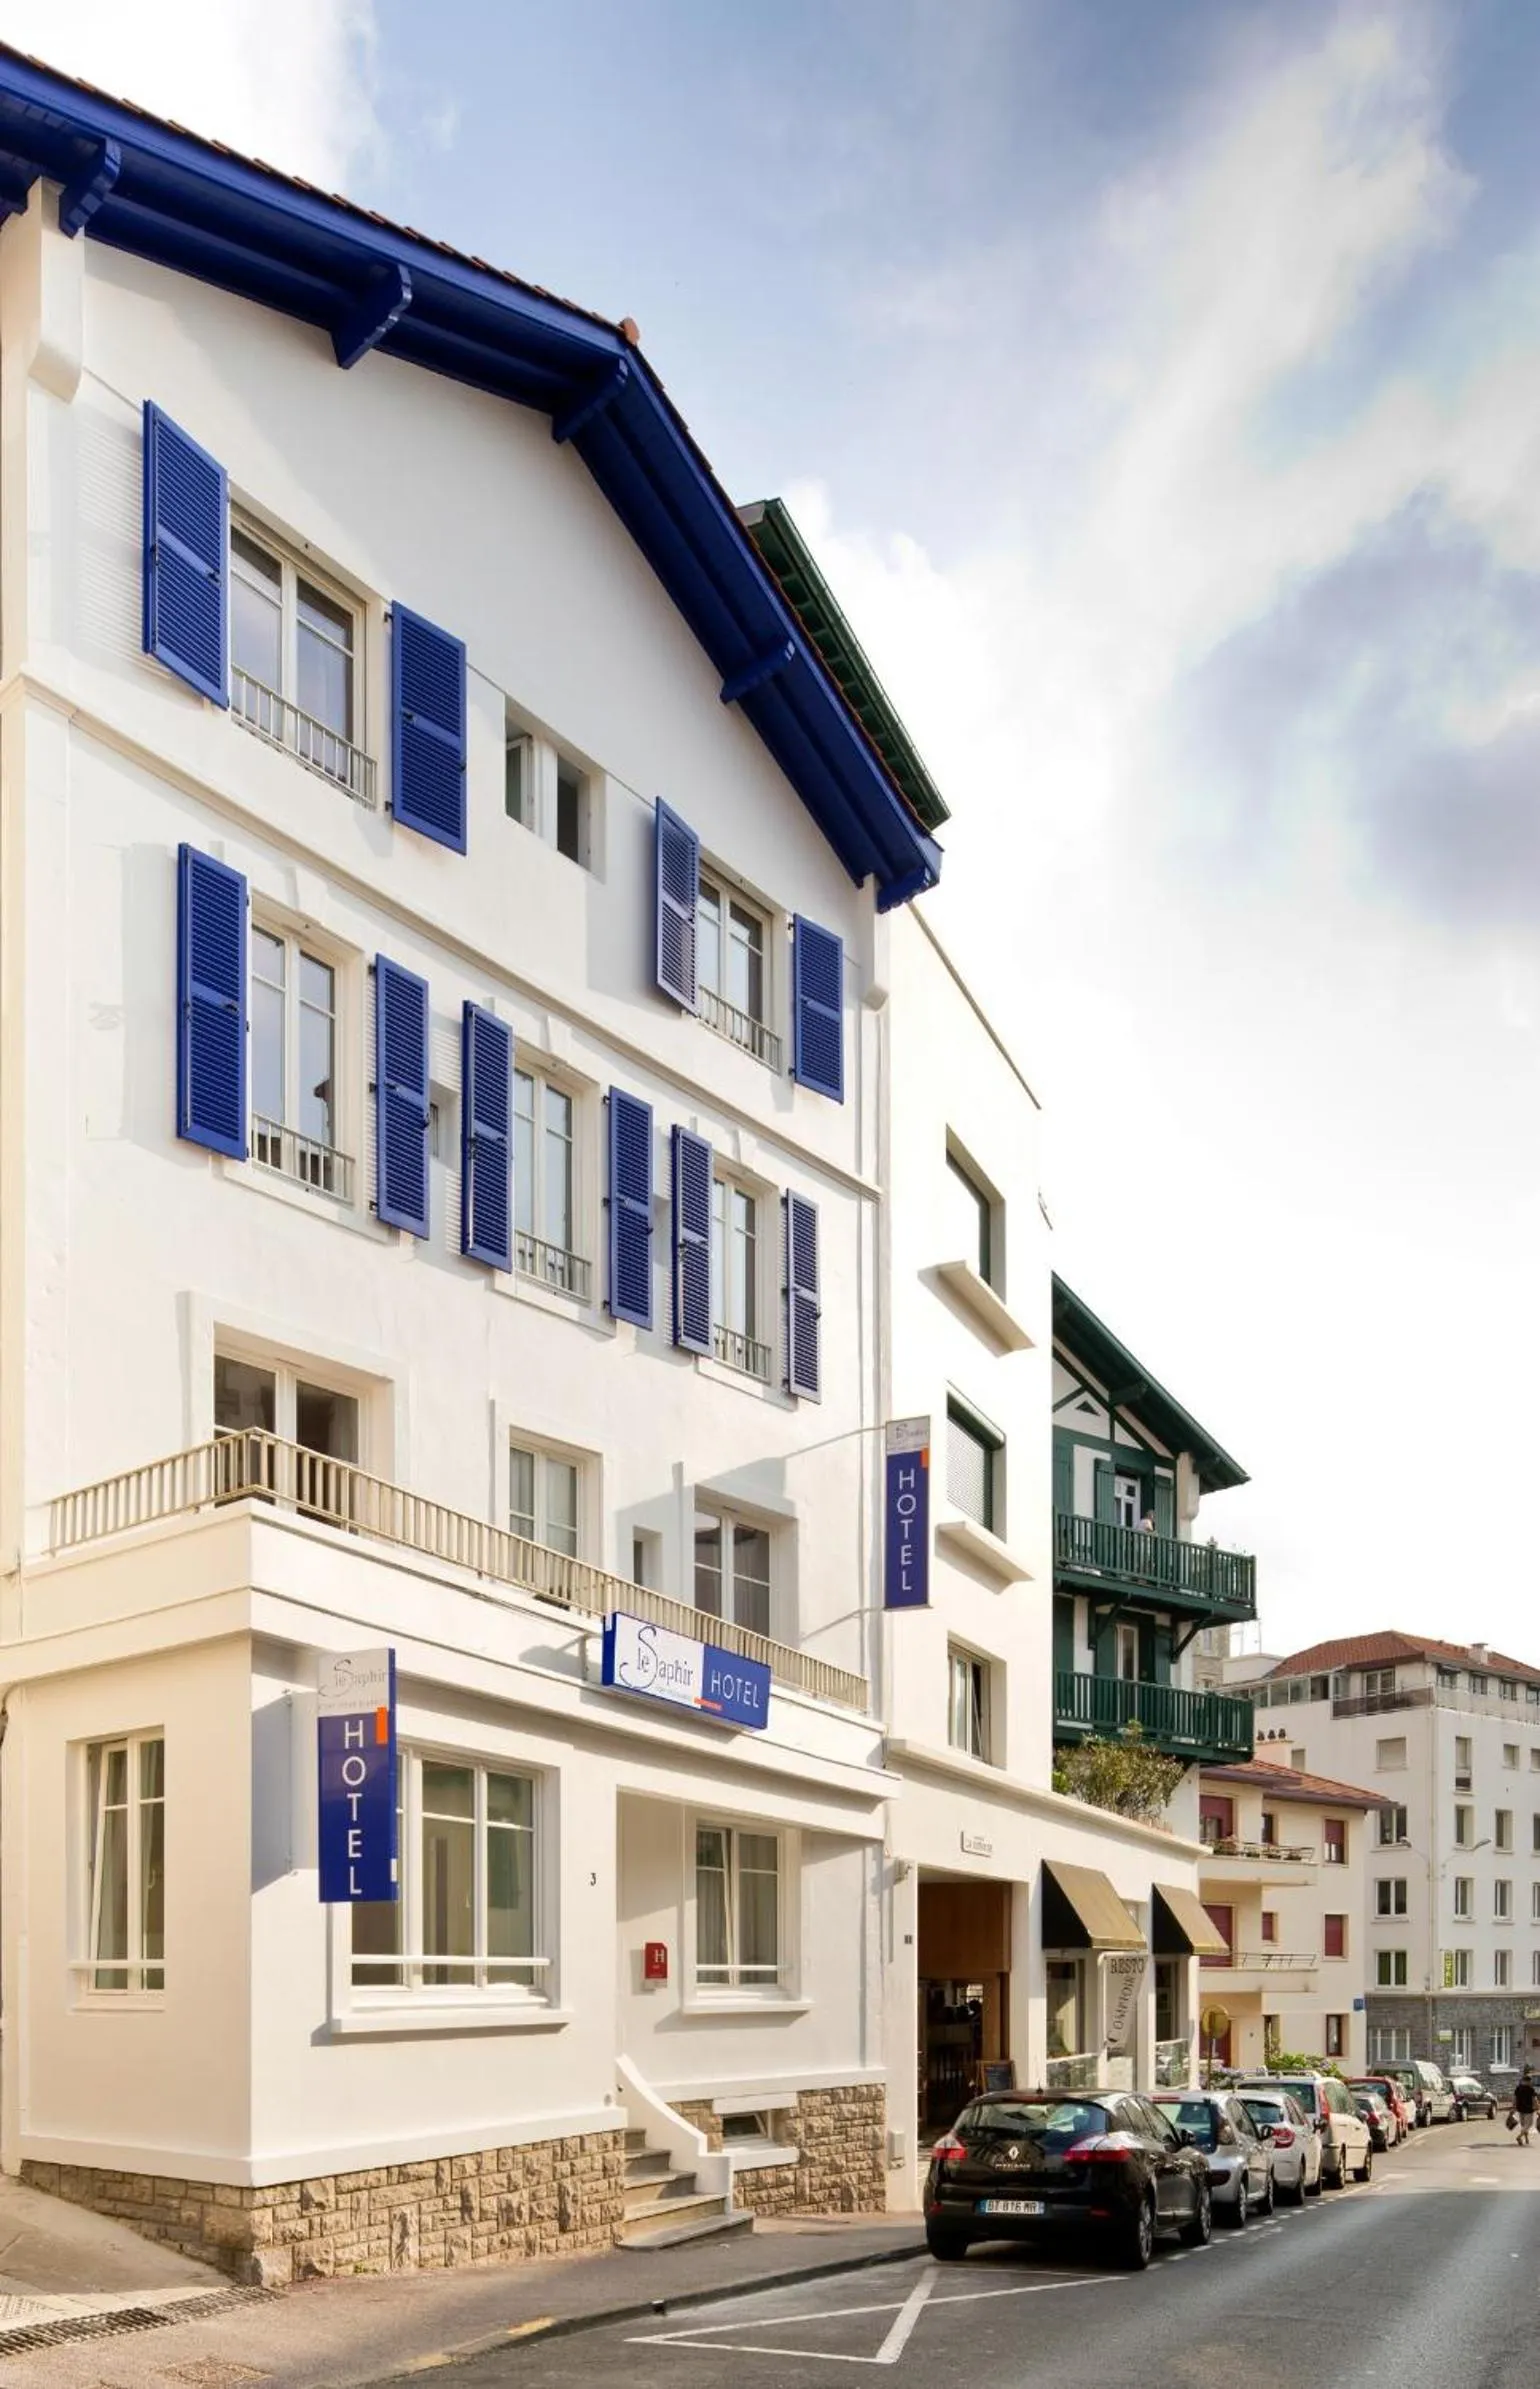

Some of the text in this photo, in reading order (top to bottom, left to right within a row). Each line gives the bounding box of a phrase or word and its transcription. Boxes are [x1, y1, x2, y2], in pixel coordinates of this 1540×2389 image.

[896, 1468, 917, 1591] HOTEL
[619, 1625, 694, 1690] Saphir
[711, 1669, 760, 1709] HOTEL
[342, 1719, 366, 1895] HOTEL
[590, 1872, 597, 1887] 3
[655, 1949, 665, 1963] H
